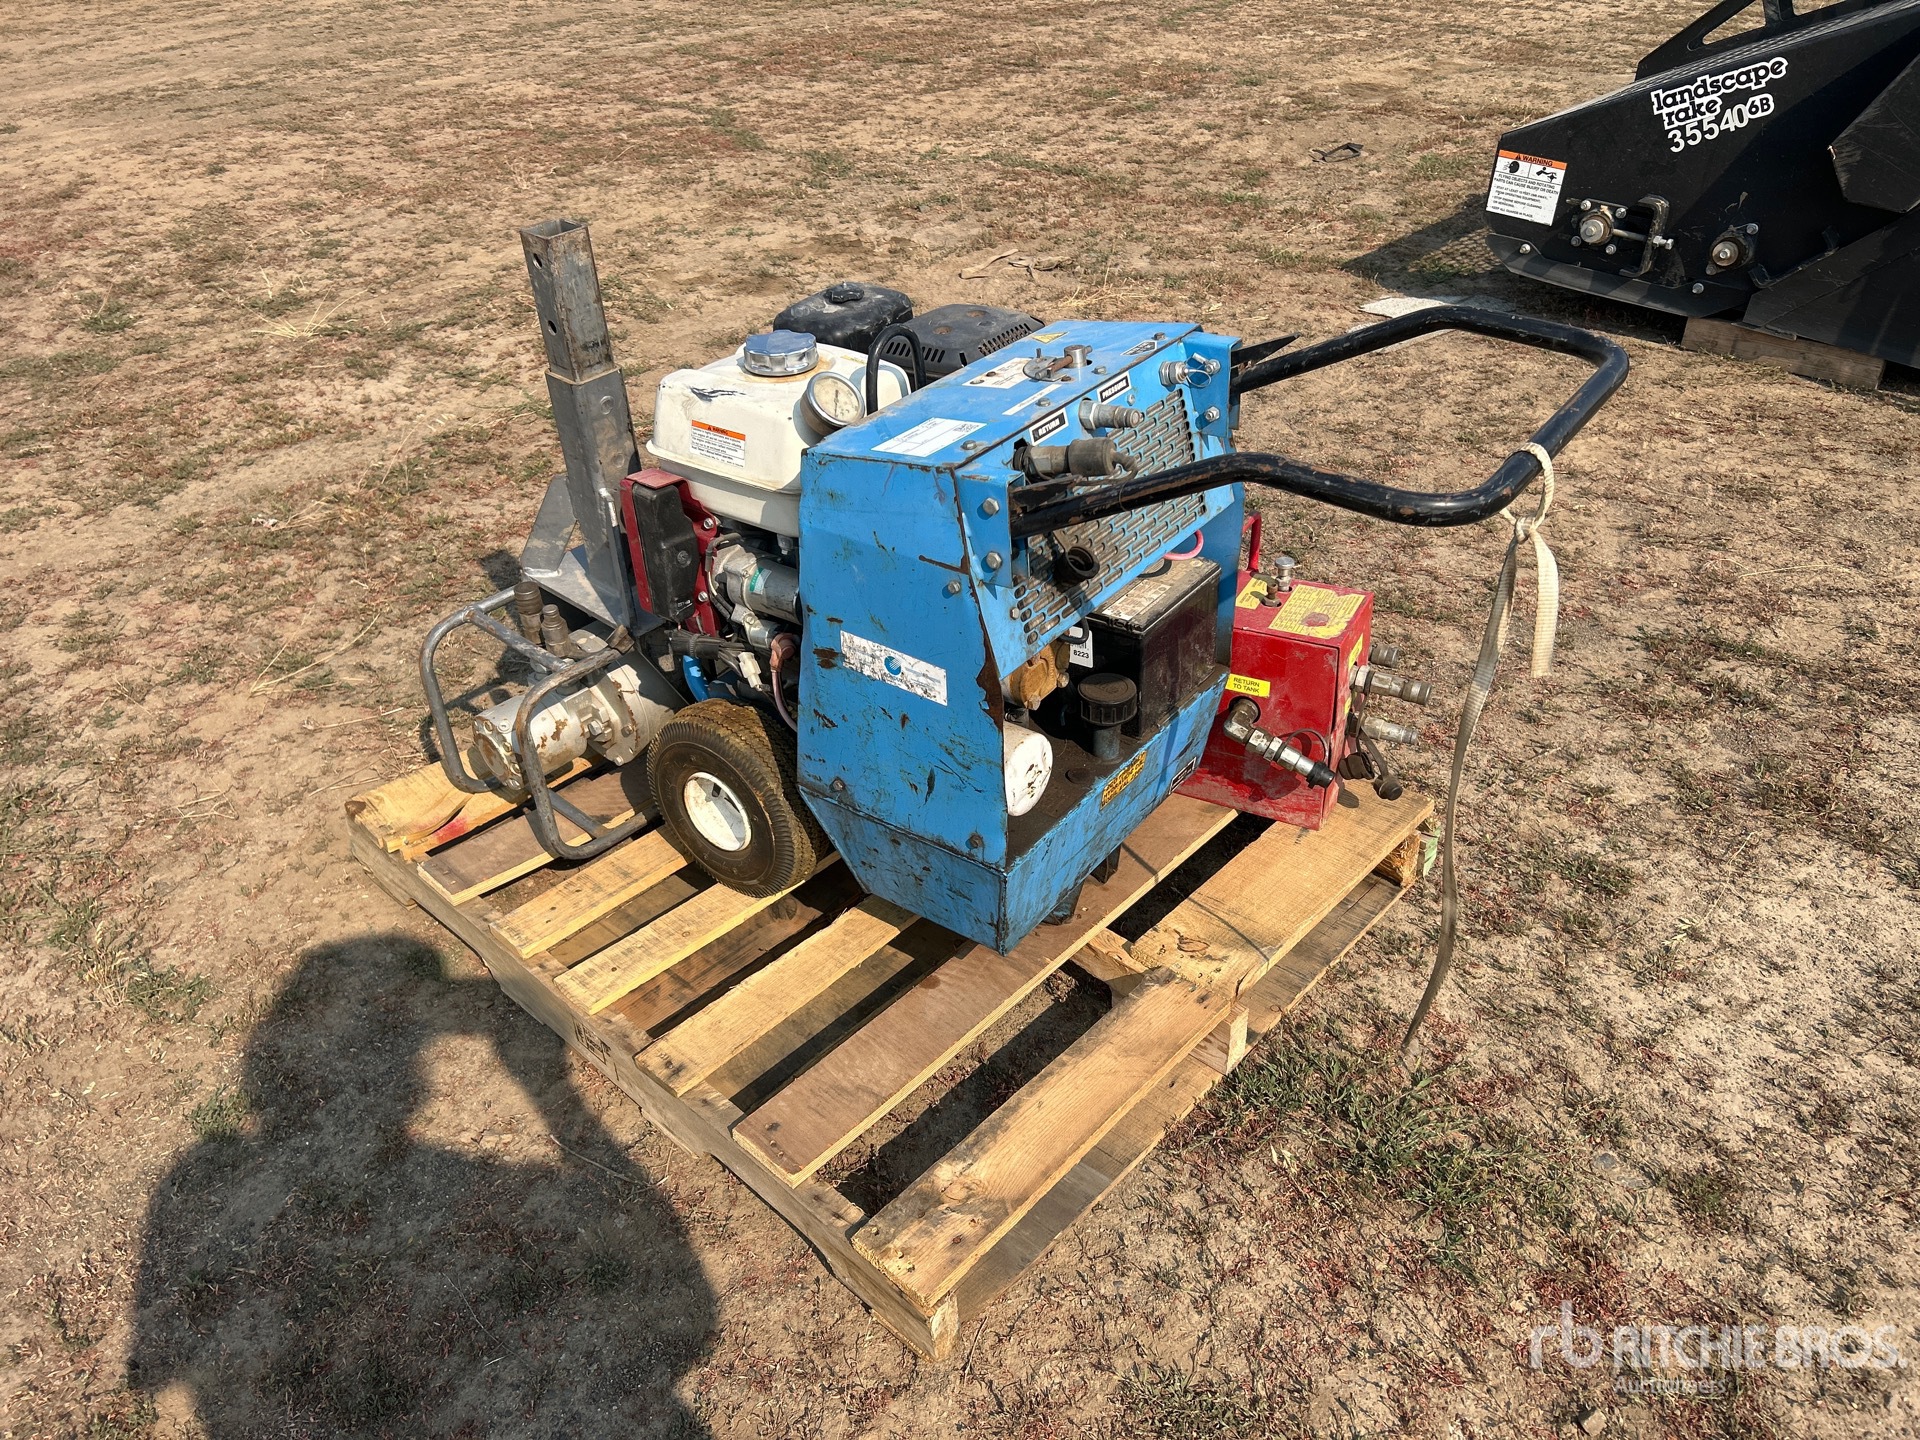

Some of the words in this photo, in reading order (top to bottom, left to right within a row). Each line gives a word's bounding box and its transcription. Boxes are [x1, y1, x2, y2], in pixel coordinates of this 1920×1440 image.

[1653, 58, 1786, 112] landscape
[1664, 98, 1719, 127] rake
[1522, 155, 1553, 167] WARNING
[1537, 181, 1555, 189] ROTATING
[1101, 379, 1127, 399] PRESSURE
[1037, 418, 1061, 437] RETURN
[1073, 649, 1090, 659] 8223
[1233, 677, 1260, 688] RETURN
[1243, 685, 1260, 694] TANK
